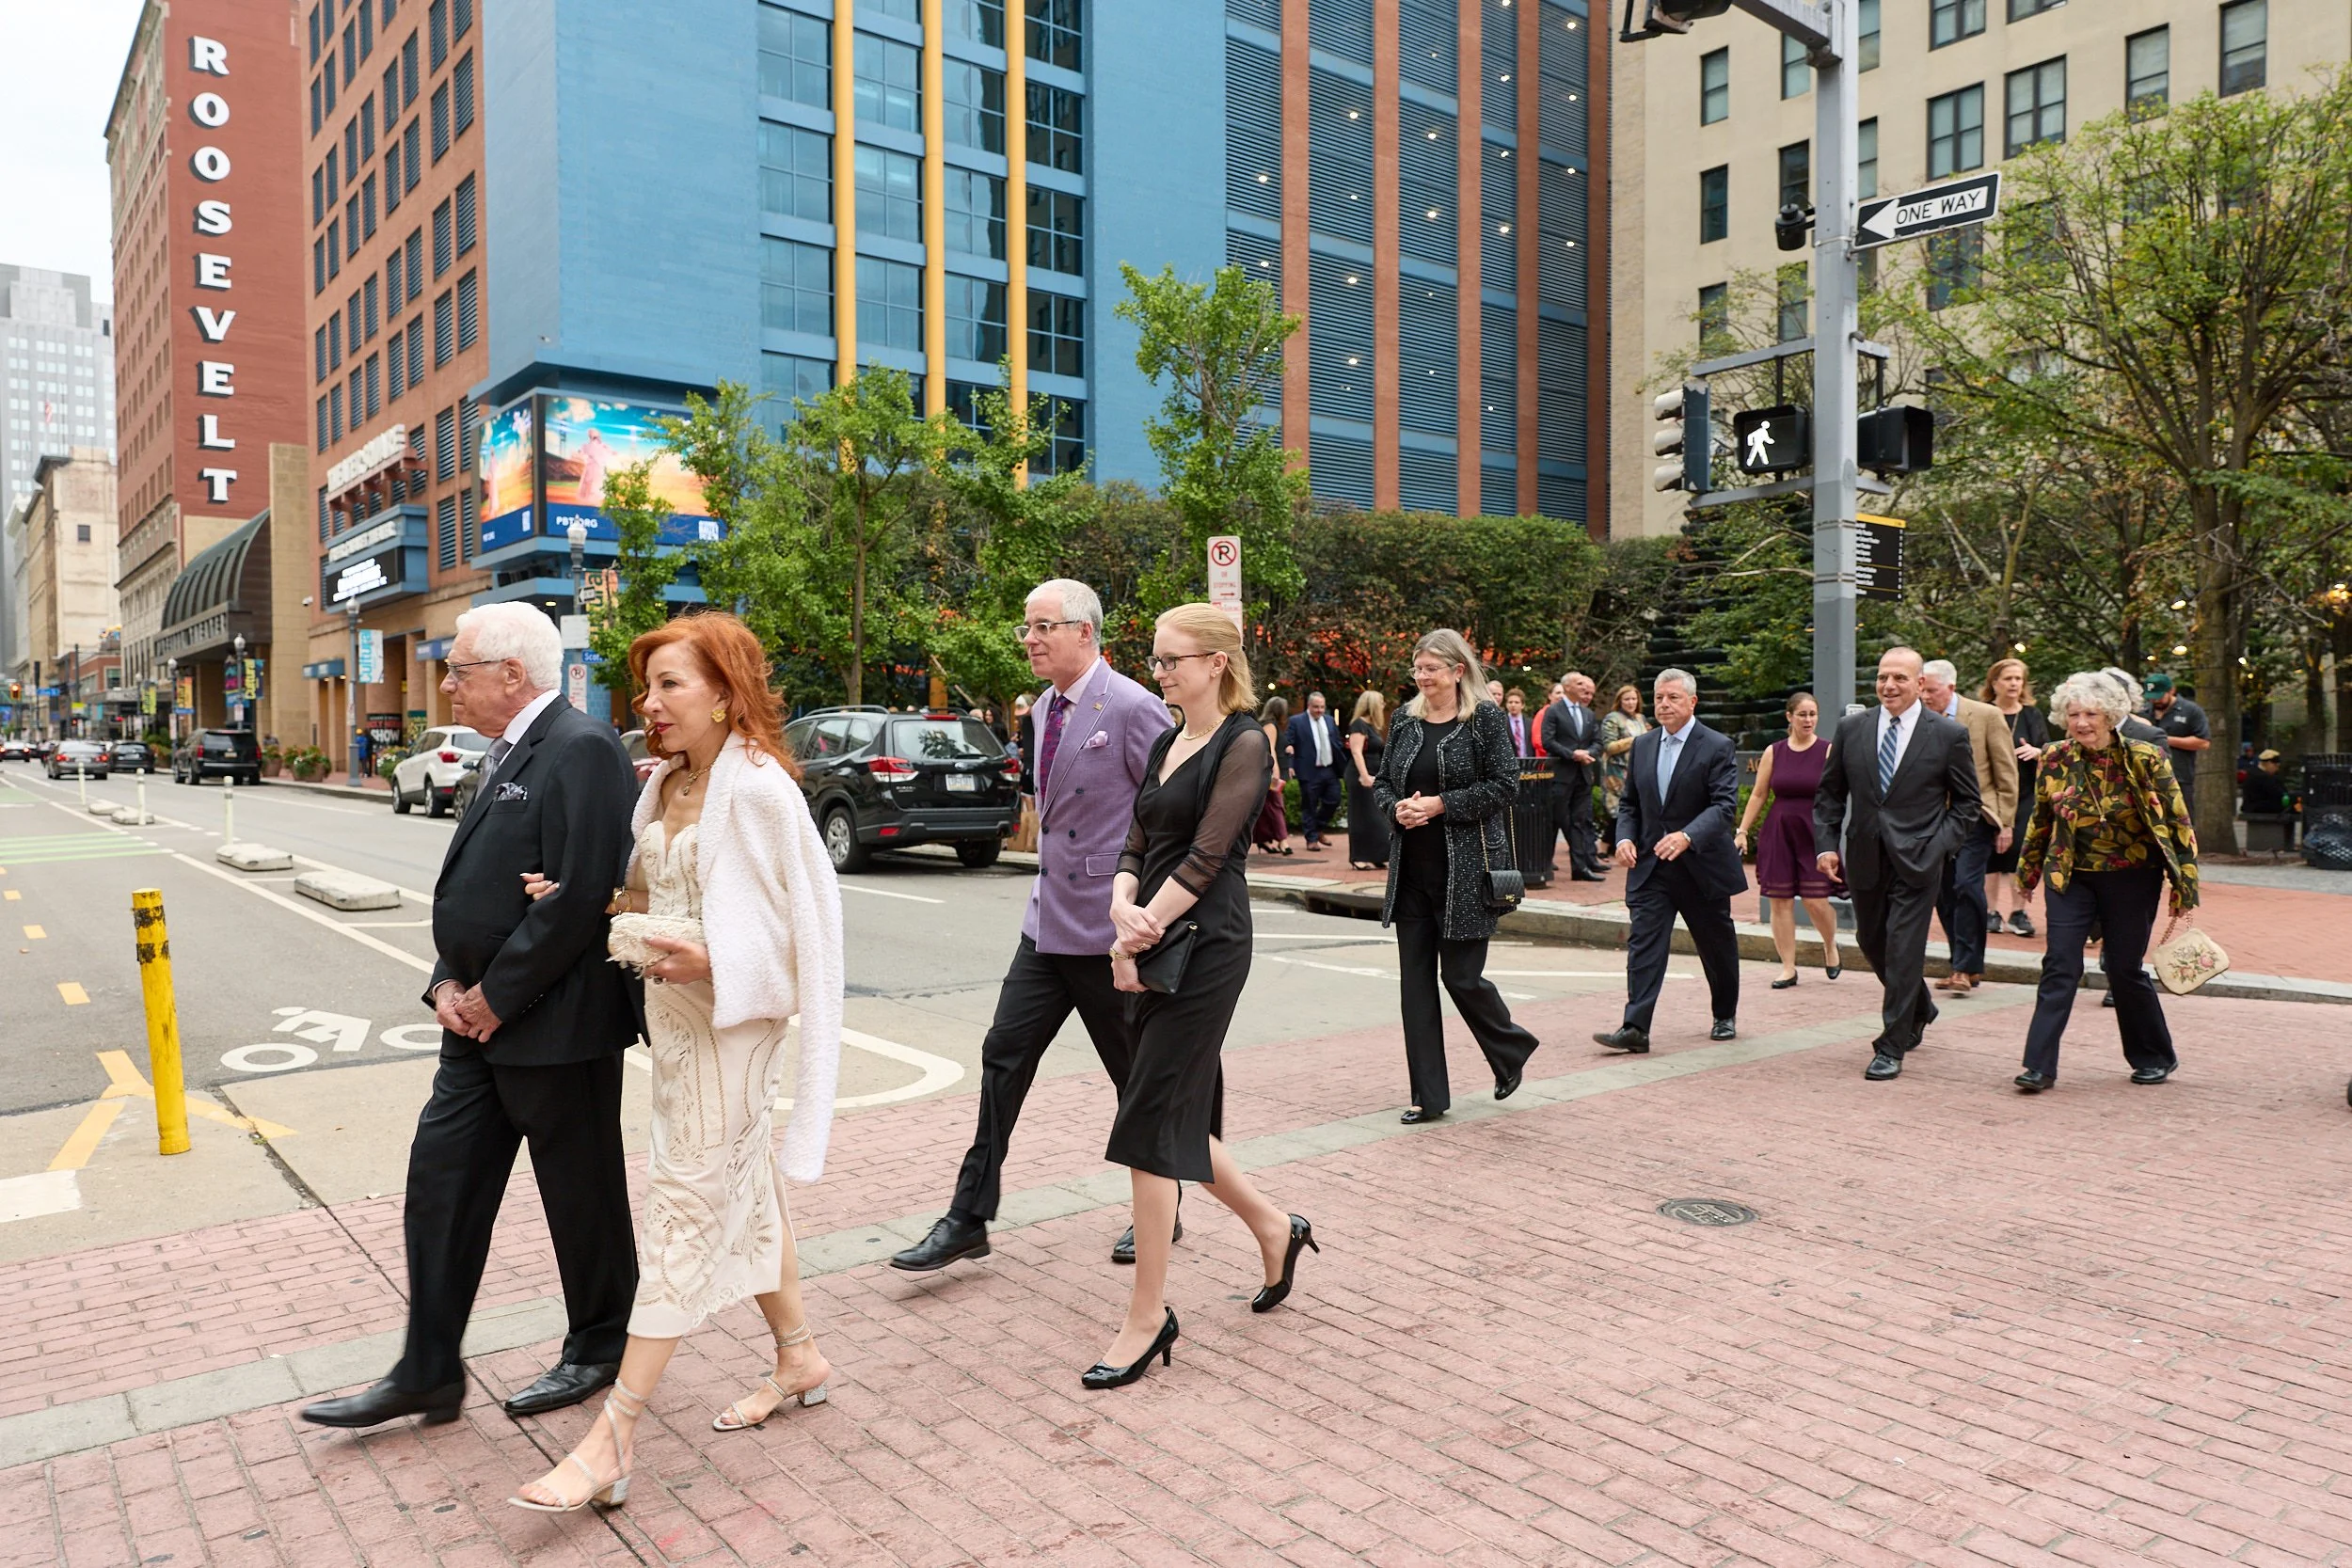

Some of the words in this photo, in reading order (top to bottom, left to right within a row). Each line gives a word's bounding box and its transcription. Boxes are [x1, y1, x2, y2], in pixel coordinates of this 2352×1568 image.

[190, 35, 237, 503] ROOSEVELT
[1896, 201, 1932, 225] ONE
[1941, 190, 1981, 214] WAY
